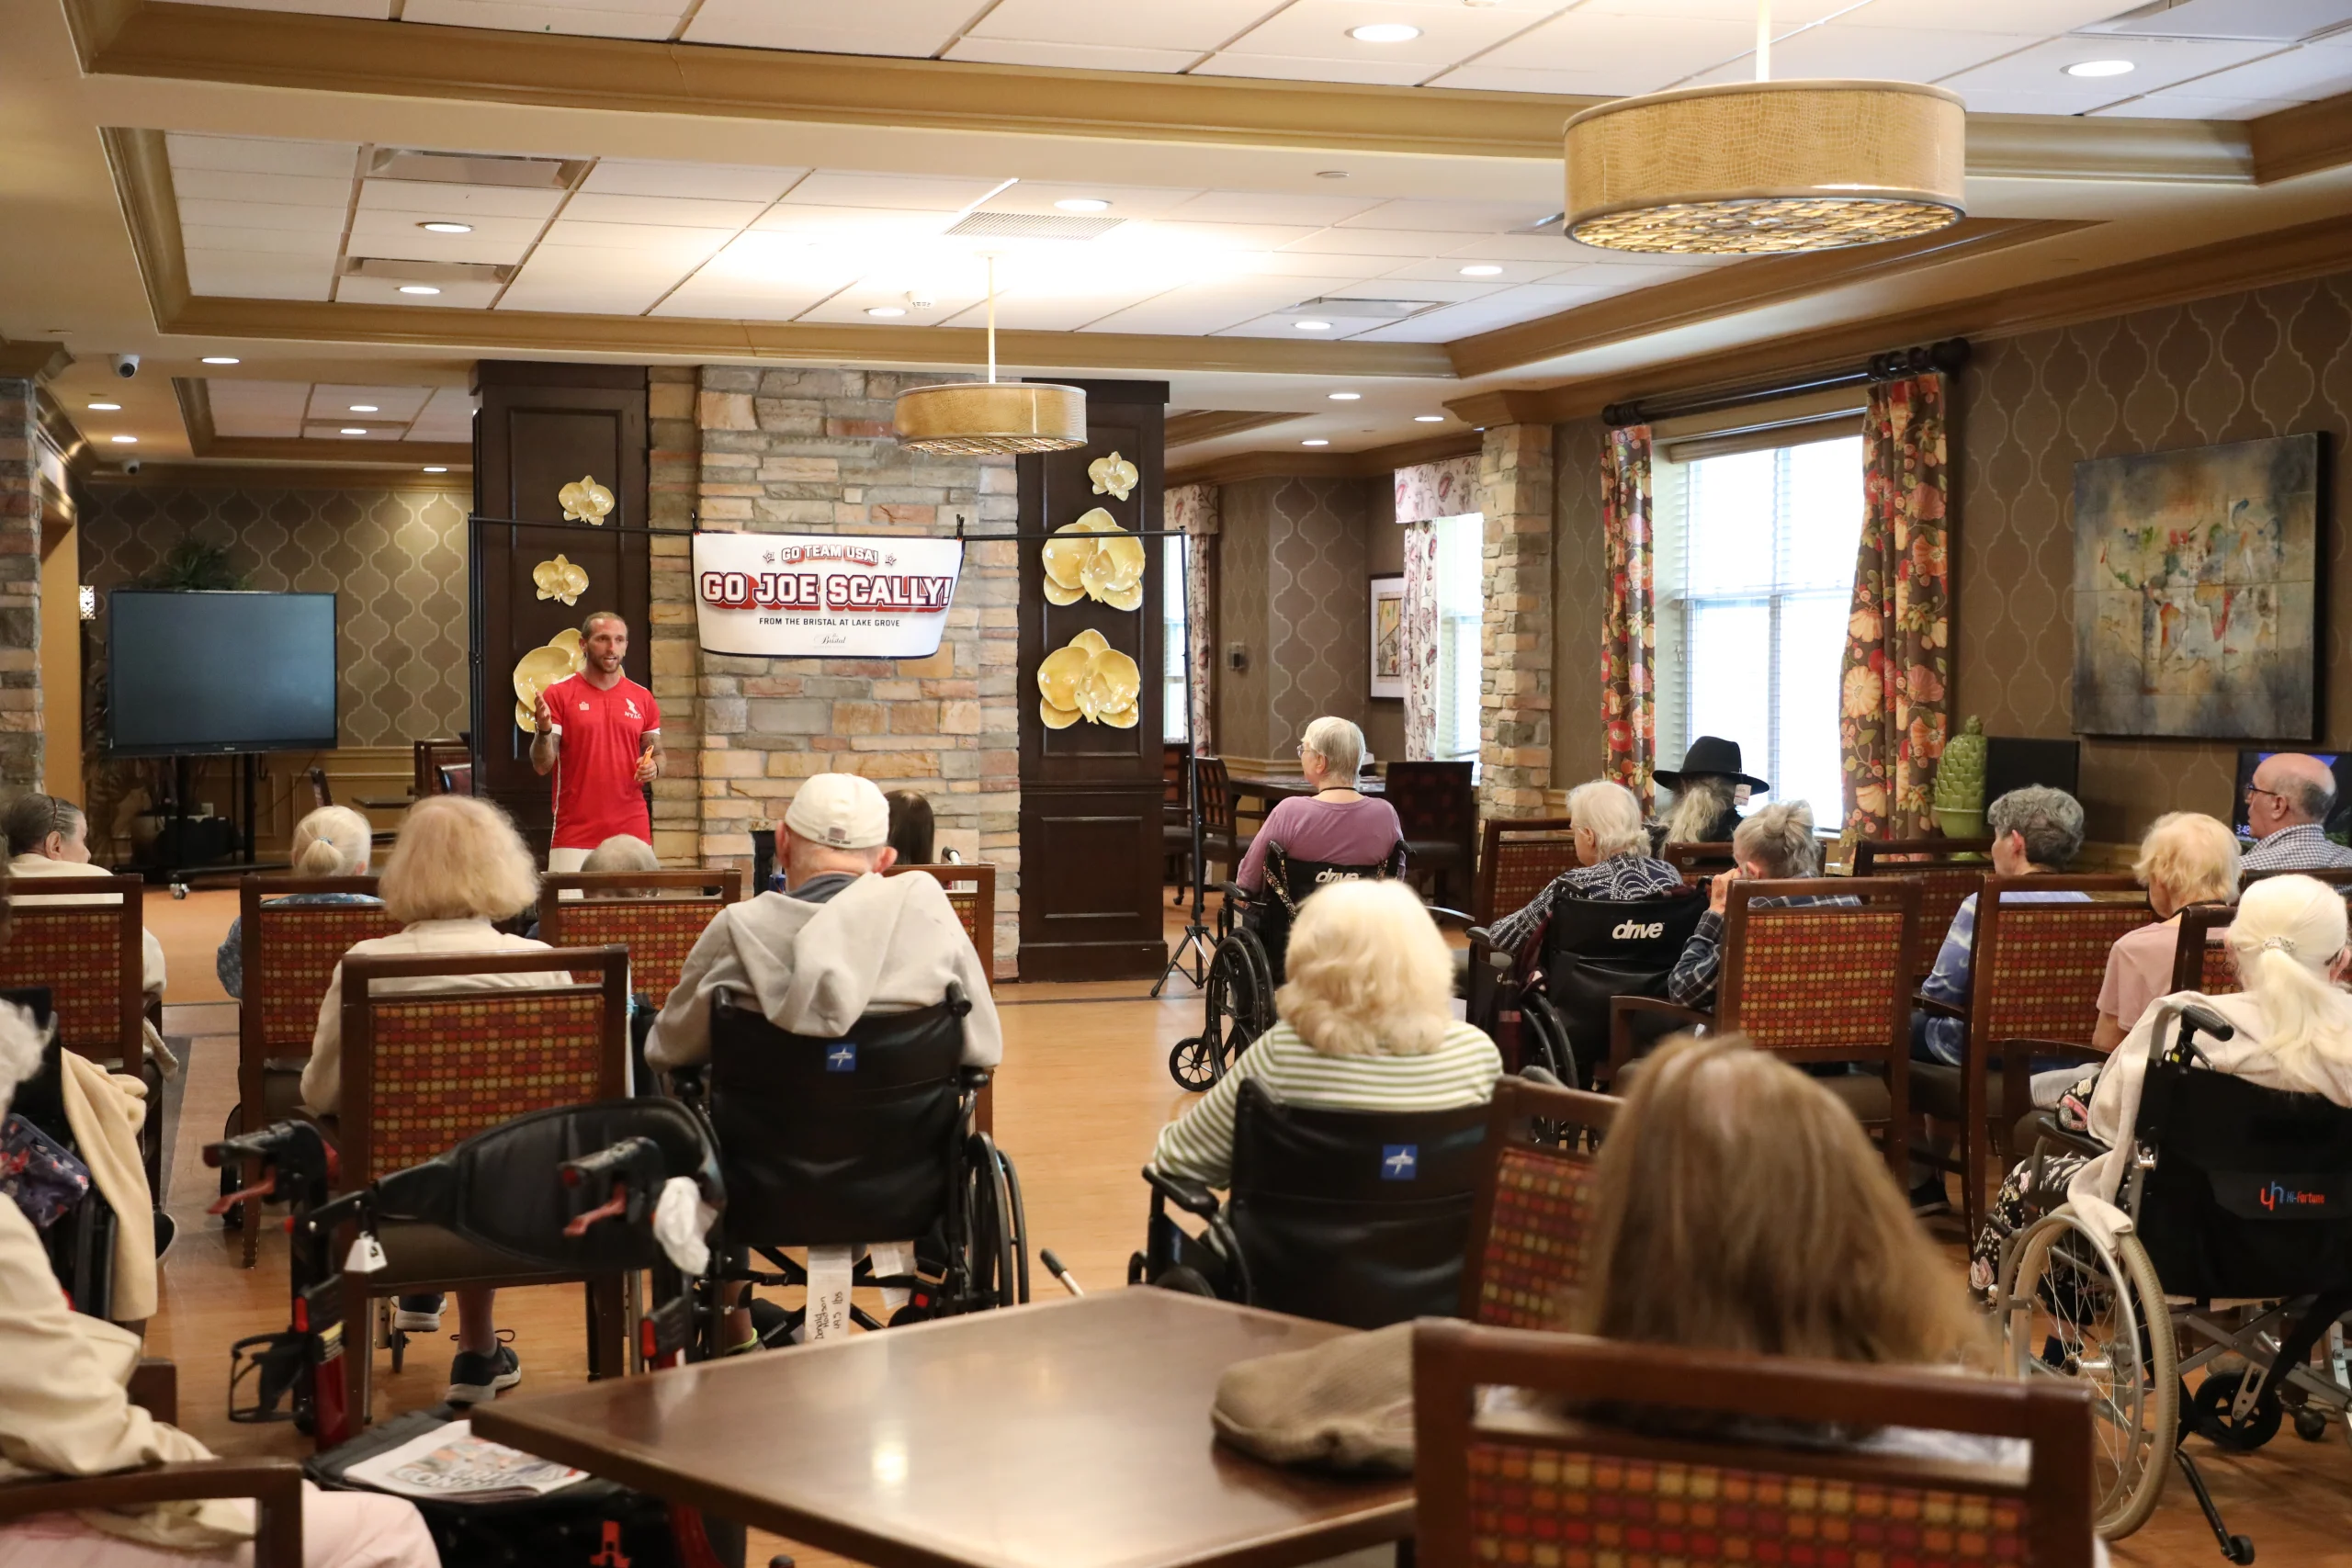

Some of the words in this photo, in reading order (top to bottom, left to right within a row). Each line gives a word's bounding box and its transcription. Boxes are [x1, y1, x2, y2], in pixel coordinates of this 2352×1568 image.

[782, 546, 802, 563] GO
[804, 544, 842, 559] TEAM
[844, 546, 879, 565] USA!
[701, 571, 749, 606] GO
[752, 572, 820, 606] JOE
[826, 574, 954, 608] SCALLY!
[759, 617, 782, 626] FROM
[786, 617, 800, 626] THE
[803, 617, 837, 626] BRISTAL
[840, 618, 849, 626] AT
[852, 618, 872, 626] LAKE
[875, 619, 900, 627] GROVE
[625, 711, 642, 719] NYAC
[1315, 868, 1360, 883] drive
[1611, 919, 1664, 940] drive
[831, 1291, 843, 1305] lbs
[814, 1314, 824, 1340] Donald
